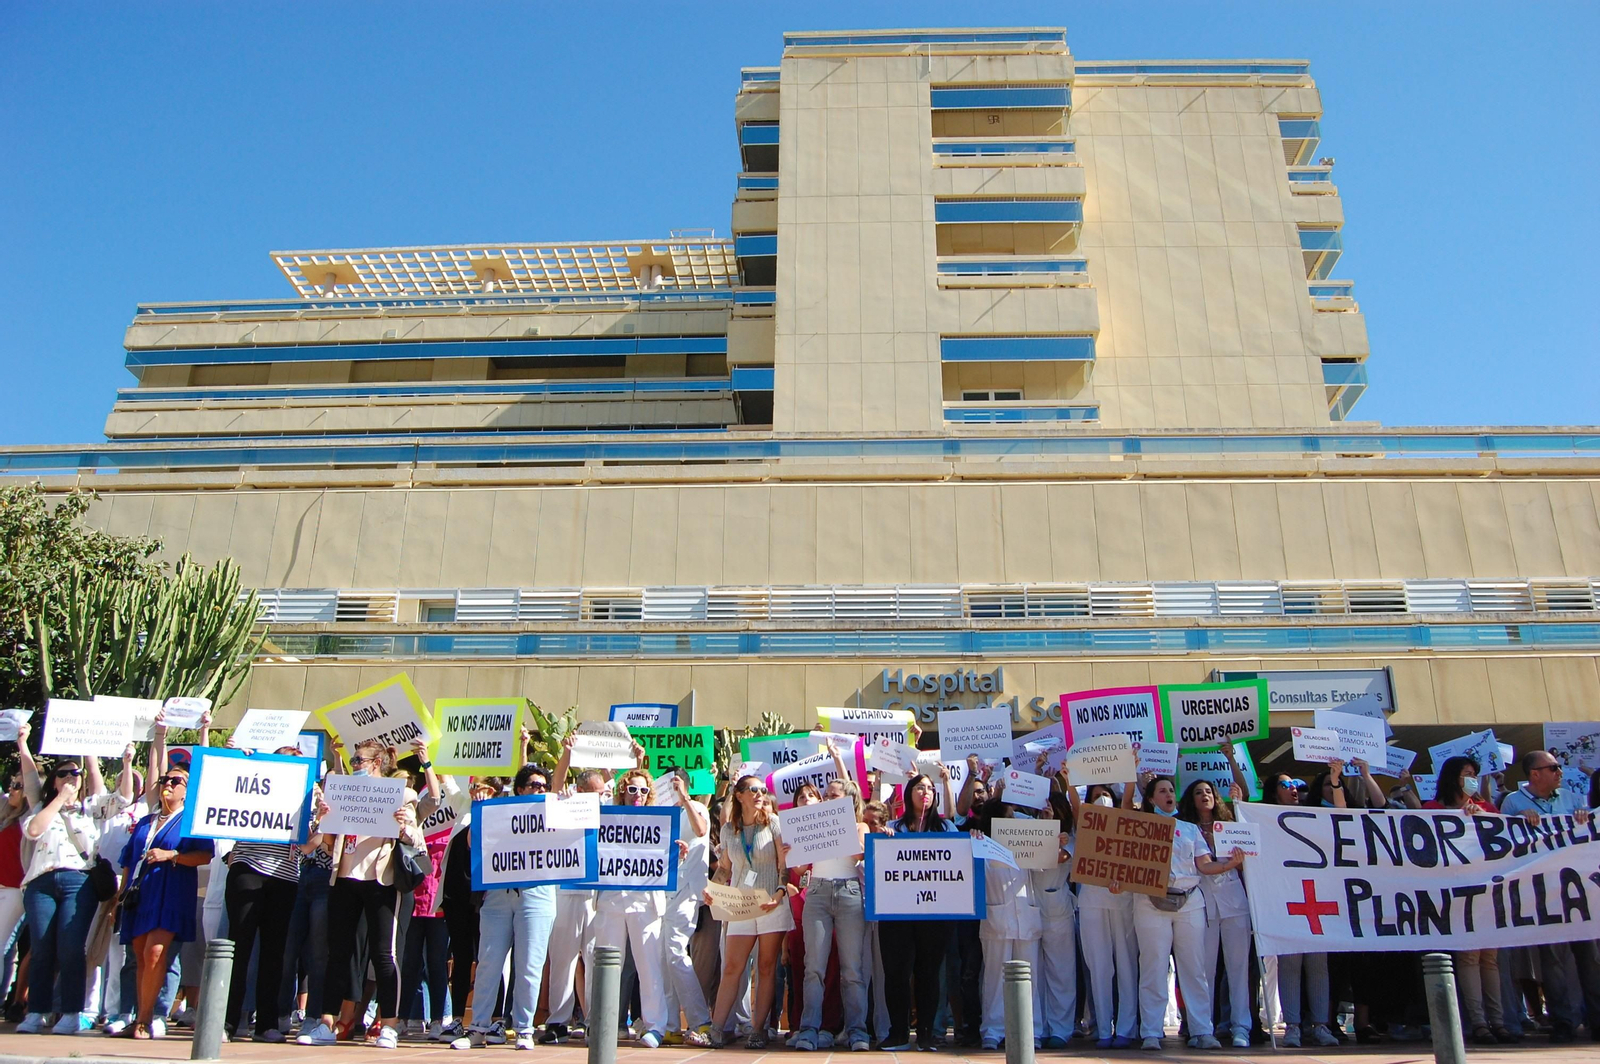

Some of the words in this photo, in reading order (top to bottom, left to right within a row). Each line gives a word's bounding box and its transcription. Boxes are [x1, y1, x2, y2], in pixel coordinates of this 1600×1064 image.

[882, 666, 1004, 698] Hospital
[1270, 690, 1328, 704] Consultas
[1331, 690, 1383, 702] Exters
[1030, 696, 1061, 722] So
[1182, 696, 1250, 716] URGENCIAS
[351, 706, 380, 727] CUIDA
[378, 702, 388, 718] A
[627, 714, 659, 722] AUMENTO
[1076, 708, 1089, 724] NO
[1090, 704, 1110, 722] NOS
[1114, 702, 1148, 720] AYUDAN
[52, 717, 90, 726] MARBELLA
[447, 716, 459, 732] NO
[460, 714, 478, 732] NOS
[478, 714, 512, 732] AYUDAN
[378, 732, 394, 748] TE
[390, 722, 422, 745] CUIDA
[578, 730, 622, 738] INCREMENTO
[1180, 719, 1254, 742] COLAPSADAS
[1349, 730, 1374, 738] BONILLA
[588, 740, 622, 748] PLANTILLA
[632, 734, 704, 748] STEPONA
[964, 742, 998, 750] ANDALUCIA
[1339, 737, 1364, 746] SITAMOS
[454, 742, 460, 759] A
[462, 741, 502, 759] CUIDARTE
[773, 748, 798, 764] MÁS
[1072, 744, 1117, 755] INCREMENTO
[1340, 746, 1366, 754] LANTILLA
[1387, 752, 1405, 760] ELADORES
[642, 756, 650, 769] O
[658, 756, 675, 769] ES
[685, 756, 704, 769] LA
[1082, 755, 1118, 763] PLANTILLA
[1186, 762, 1198, 771] DE
[1201, 762, 1247, 772] PLANTLA
[235, 774, 270, 795] MÁS
[811, 773, 824, 788] TE
[338, 784, 360, 792] VENDE
[372, 786, 394, 794] SALUD
[368, 796, 395, 804] BARATO
[340, 805, 371, 813] HOSPITAL
[205, 807, 293, 831] PERSONAL
[343, 816, 378, 824] PERSONAL
[422, 806, 457, 829] RSON.
[512, 814, 545, 834] CUIDA
[787, 817, 801, 825] CON
[802, 814, 816, 822] ESTE
[817, 810, 836, 818] RATIO
[796, 822, 831, 833] PACIENTES,
[998, 828, 1043, 836] INCREMENTO
[1082, 812, 1108, 832] SIN
[1116, 816, 1173, 843] PERSONAL
[598, 825, 660, 844] RGENCIAS
[794, 833, 825, 844] PERSONAL
[1277, 810, 1470, 868] SEÑOR
[1472, 812, 1600, 861] BONILL
[804, 840, 839, 852] SUFICIENTE
[1096, 836, 1170, 864] DETERIORO
[492, 851, 526, 872] QUIEN
[529, 850, 543, 869] TE
[546, 848, 579, 868] CUIDA
[896, 849, 952, 861] AUMENTO
[599, 858, 664, 877] LAPSADAS
[1076, 857, 1163, 889] ASISTENCIAL
[884, 870, 899, 882] DE
[903, 870, 964, 881] PLANTILLA
[711, 890, 751, 901] INCREMENTO
[916, 891, 937, 904] ¡YA!
